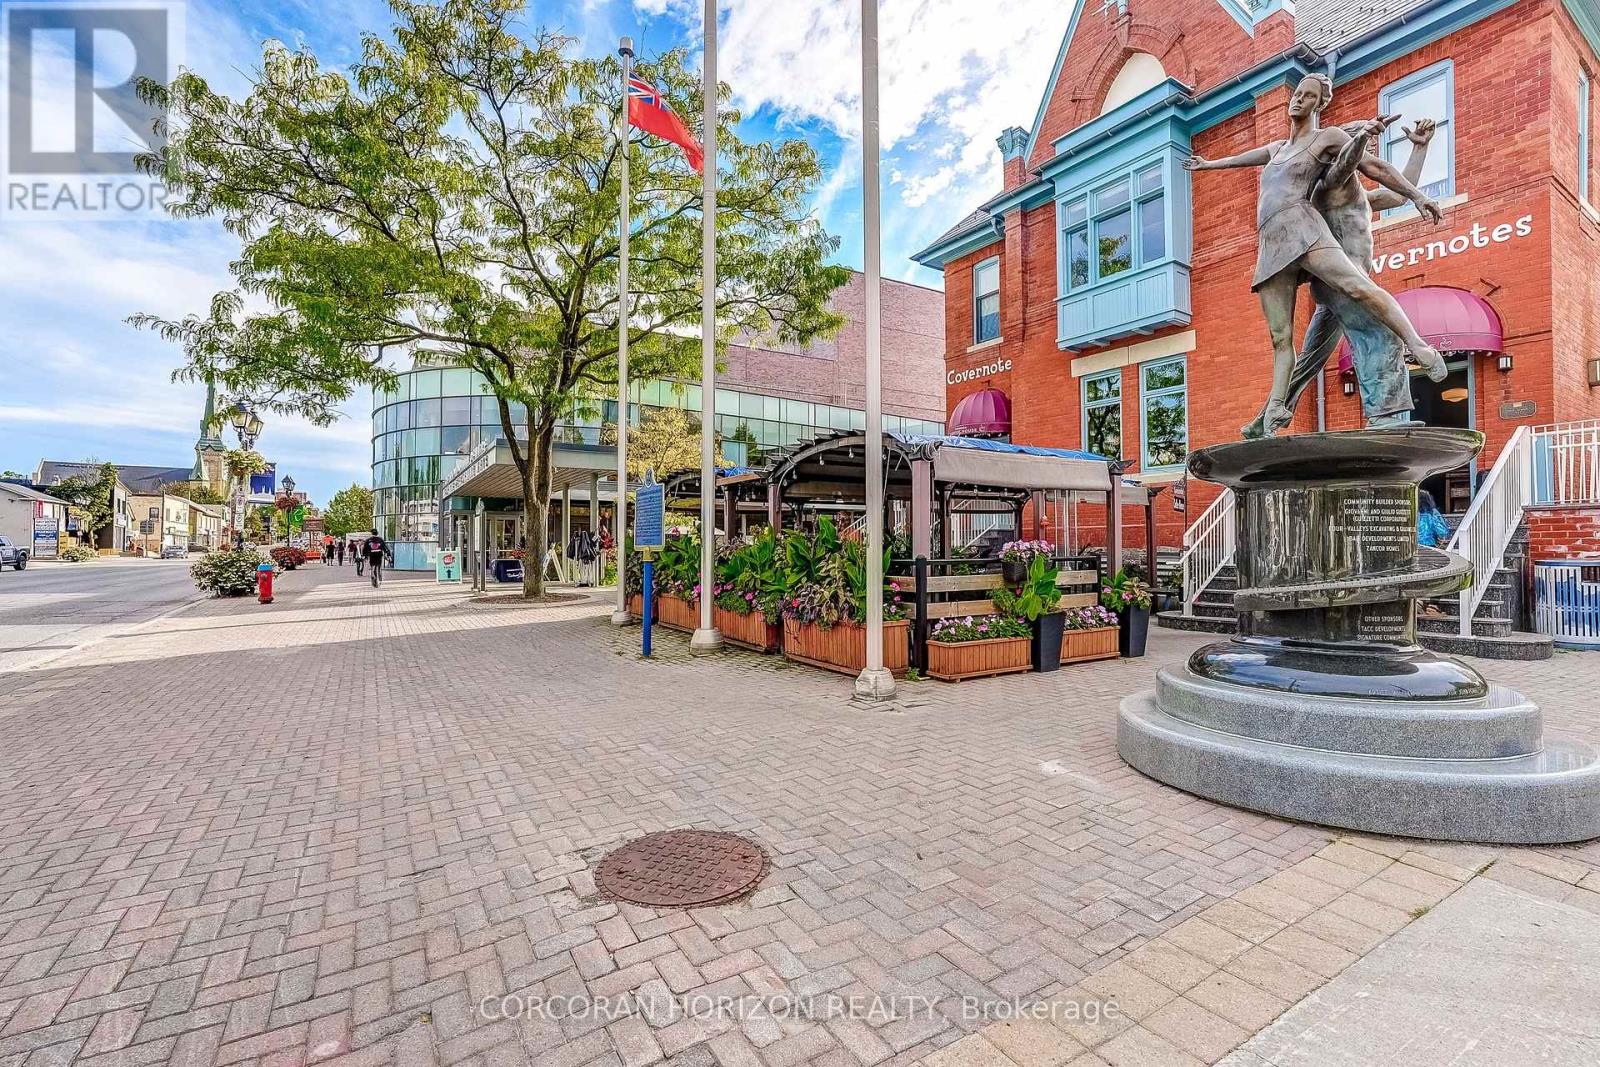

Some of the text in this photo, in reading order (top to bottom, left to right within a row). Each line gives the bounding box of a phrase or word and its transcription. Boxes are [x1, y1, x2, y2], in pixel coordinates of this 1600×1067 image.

[1371, 214, 1534, 275] vernotes
[946, 356, 1012, 385] Covernote
[1343, 498, 1375, 506] COMMUNITY
